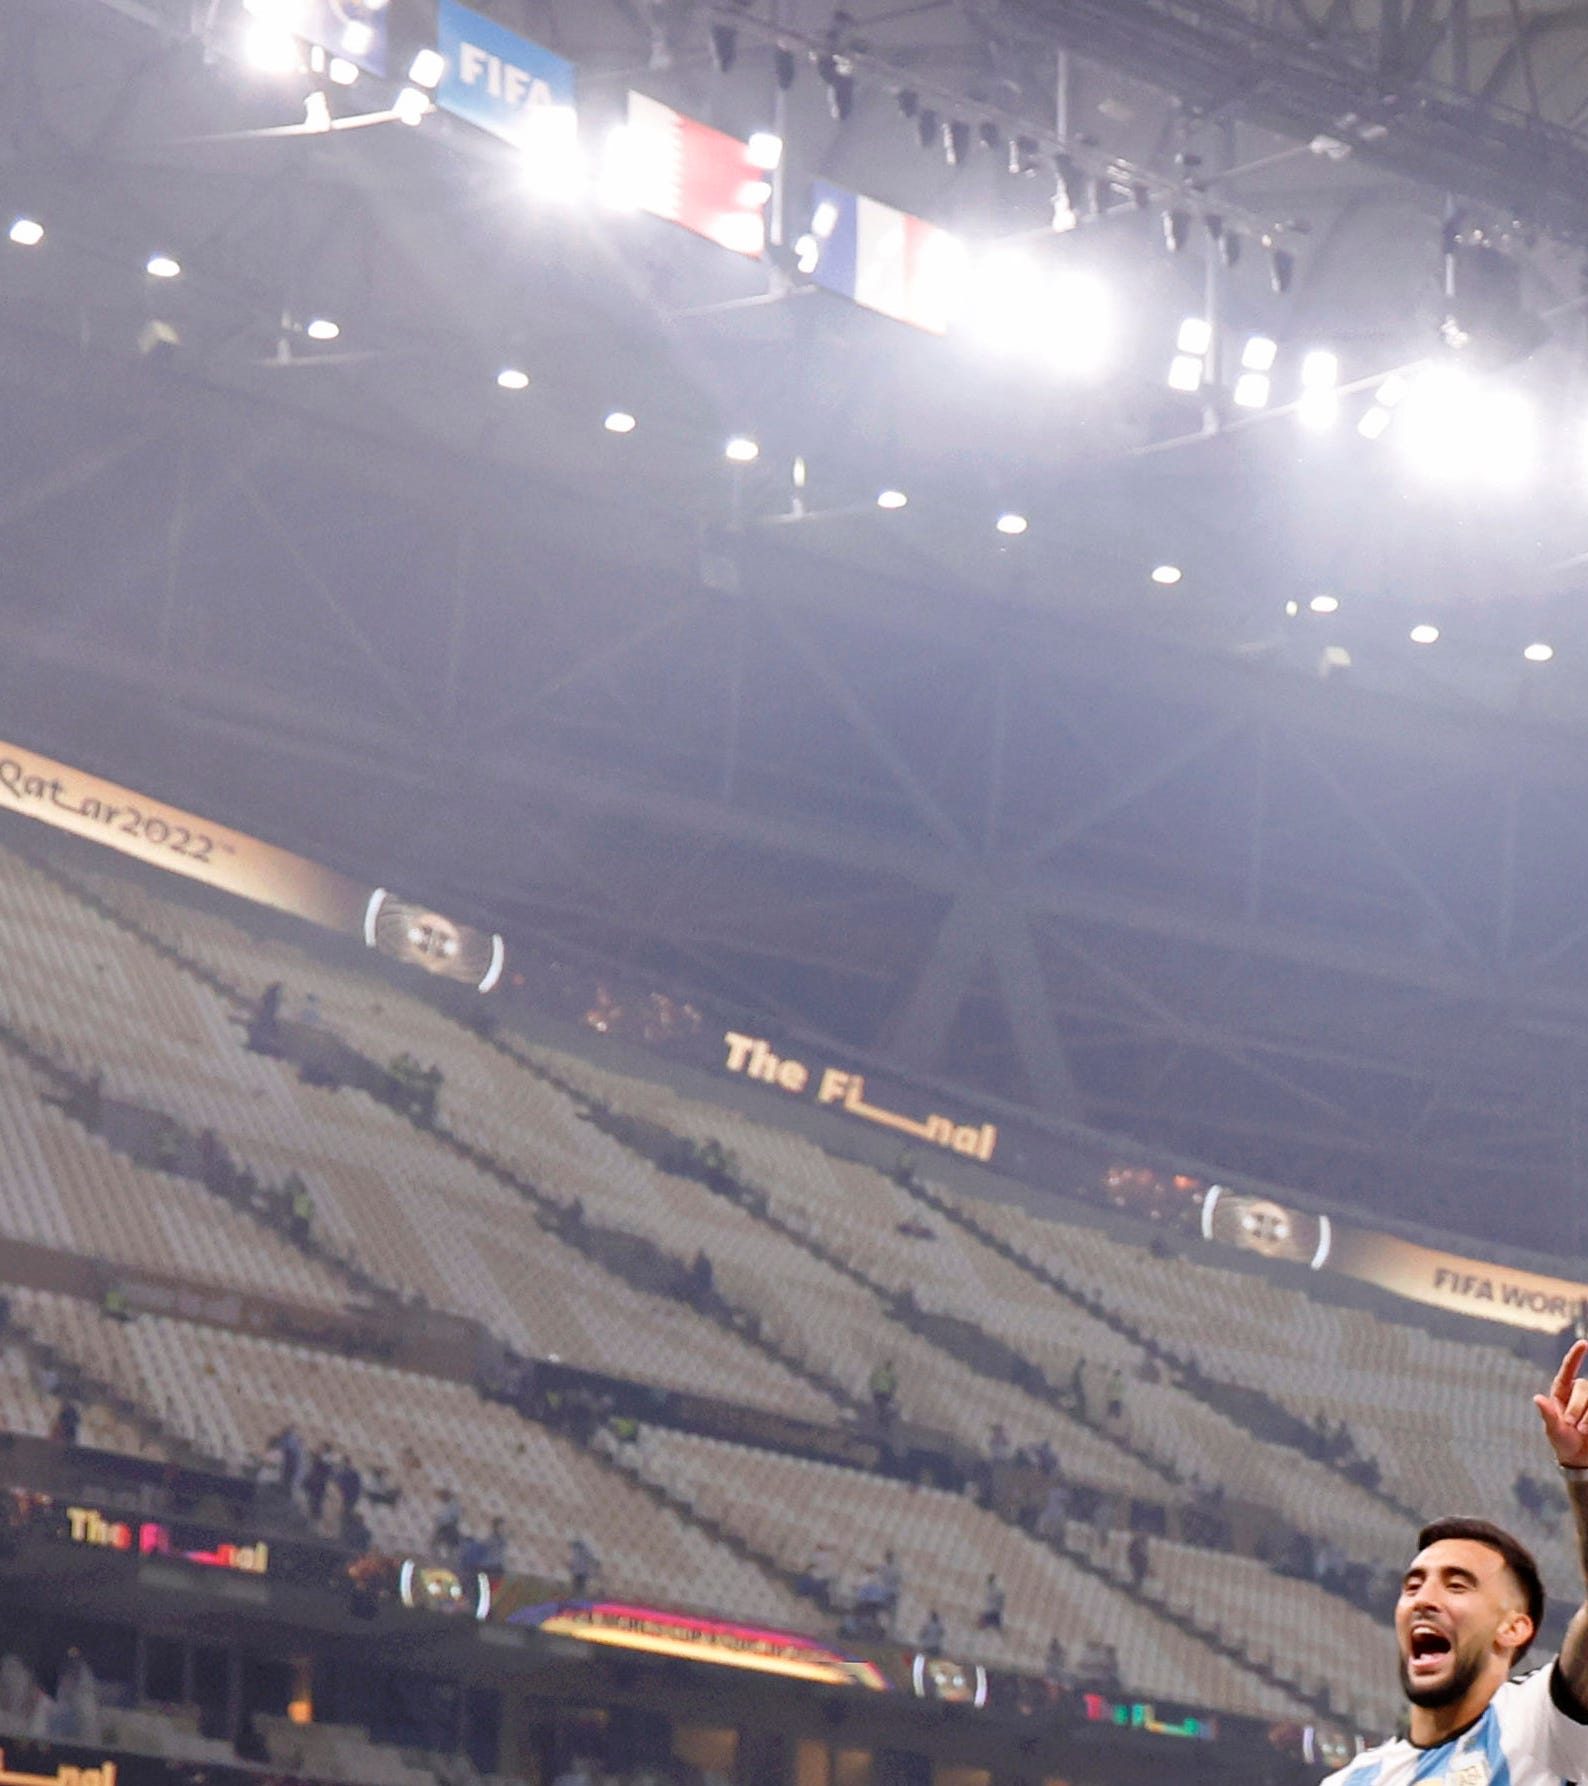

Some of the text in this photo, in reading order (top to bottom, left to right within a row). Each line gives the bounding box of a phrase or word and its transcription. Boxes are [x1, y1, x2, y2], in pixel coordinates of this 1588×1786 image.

[459, 41, 553, 108] FIFA
[724, 1031, 809, 1093] The
[1434, 1266, 1494, 1302] FIFA
